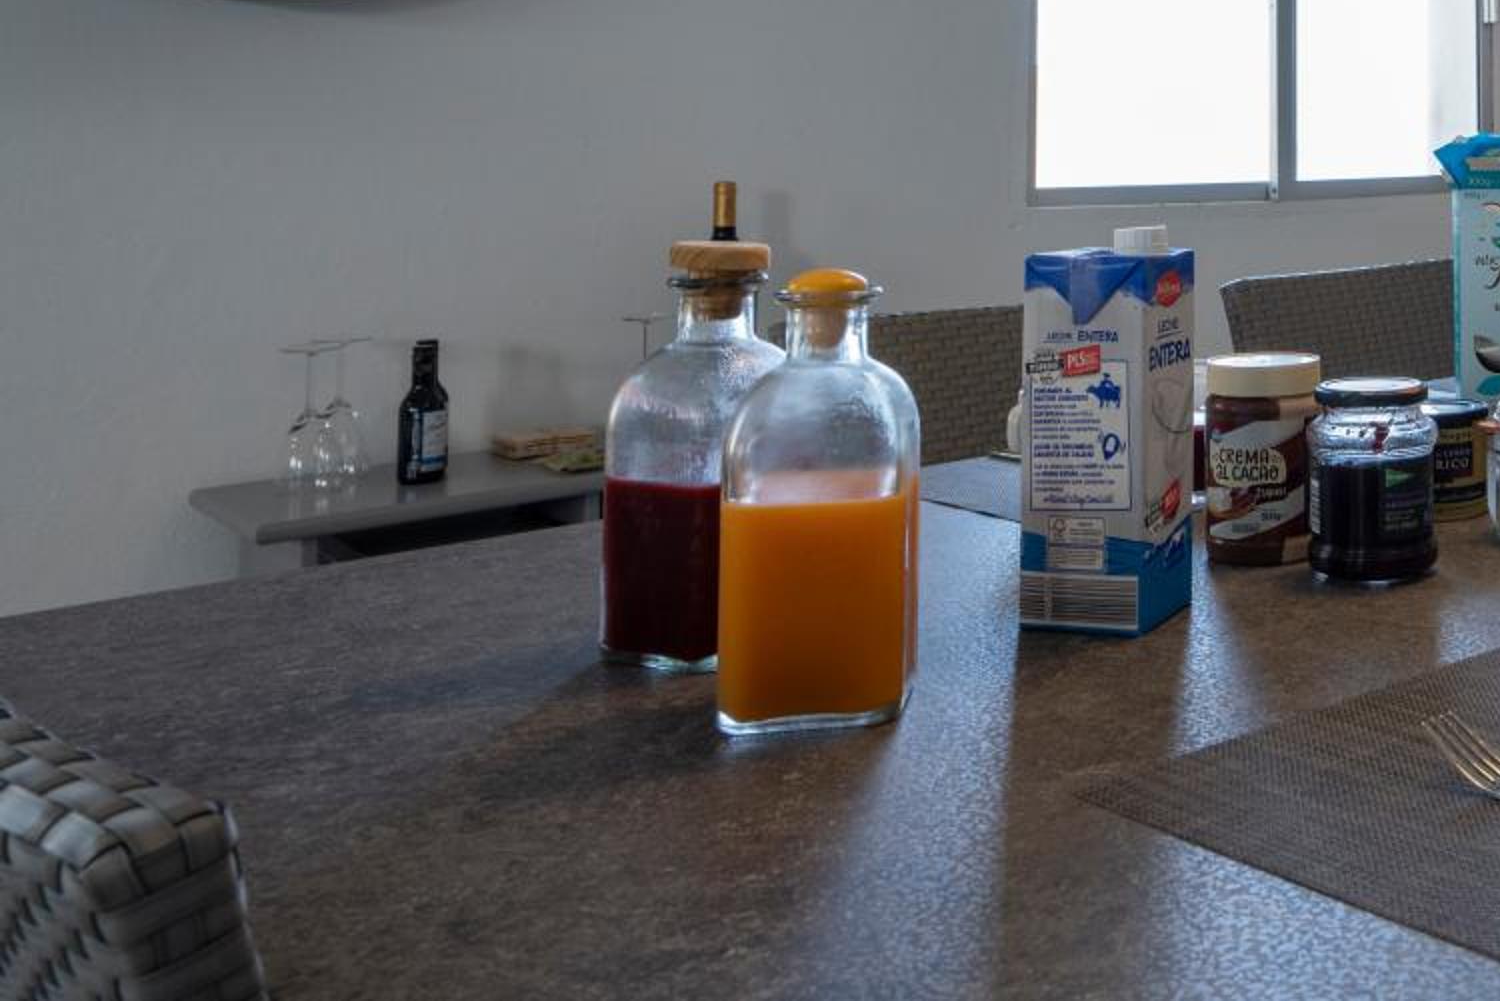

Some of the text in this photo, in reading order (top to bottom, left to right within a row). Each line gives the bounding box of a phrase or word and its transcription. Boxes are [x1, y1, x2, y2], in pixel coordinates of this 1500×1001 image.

[1077, 330, 1119, 343] ENTERA
[1148, 337, 1192, 372] ENTERA
[1218, 447, 1269, 464] CREMA
[1231, 464, 1279, 482] CACAO
